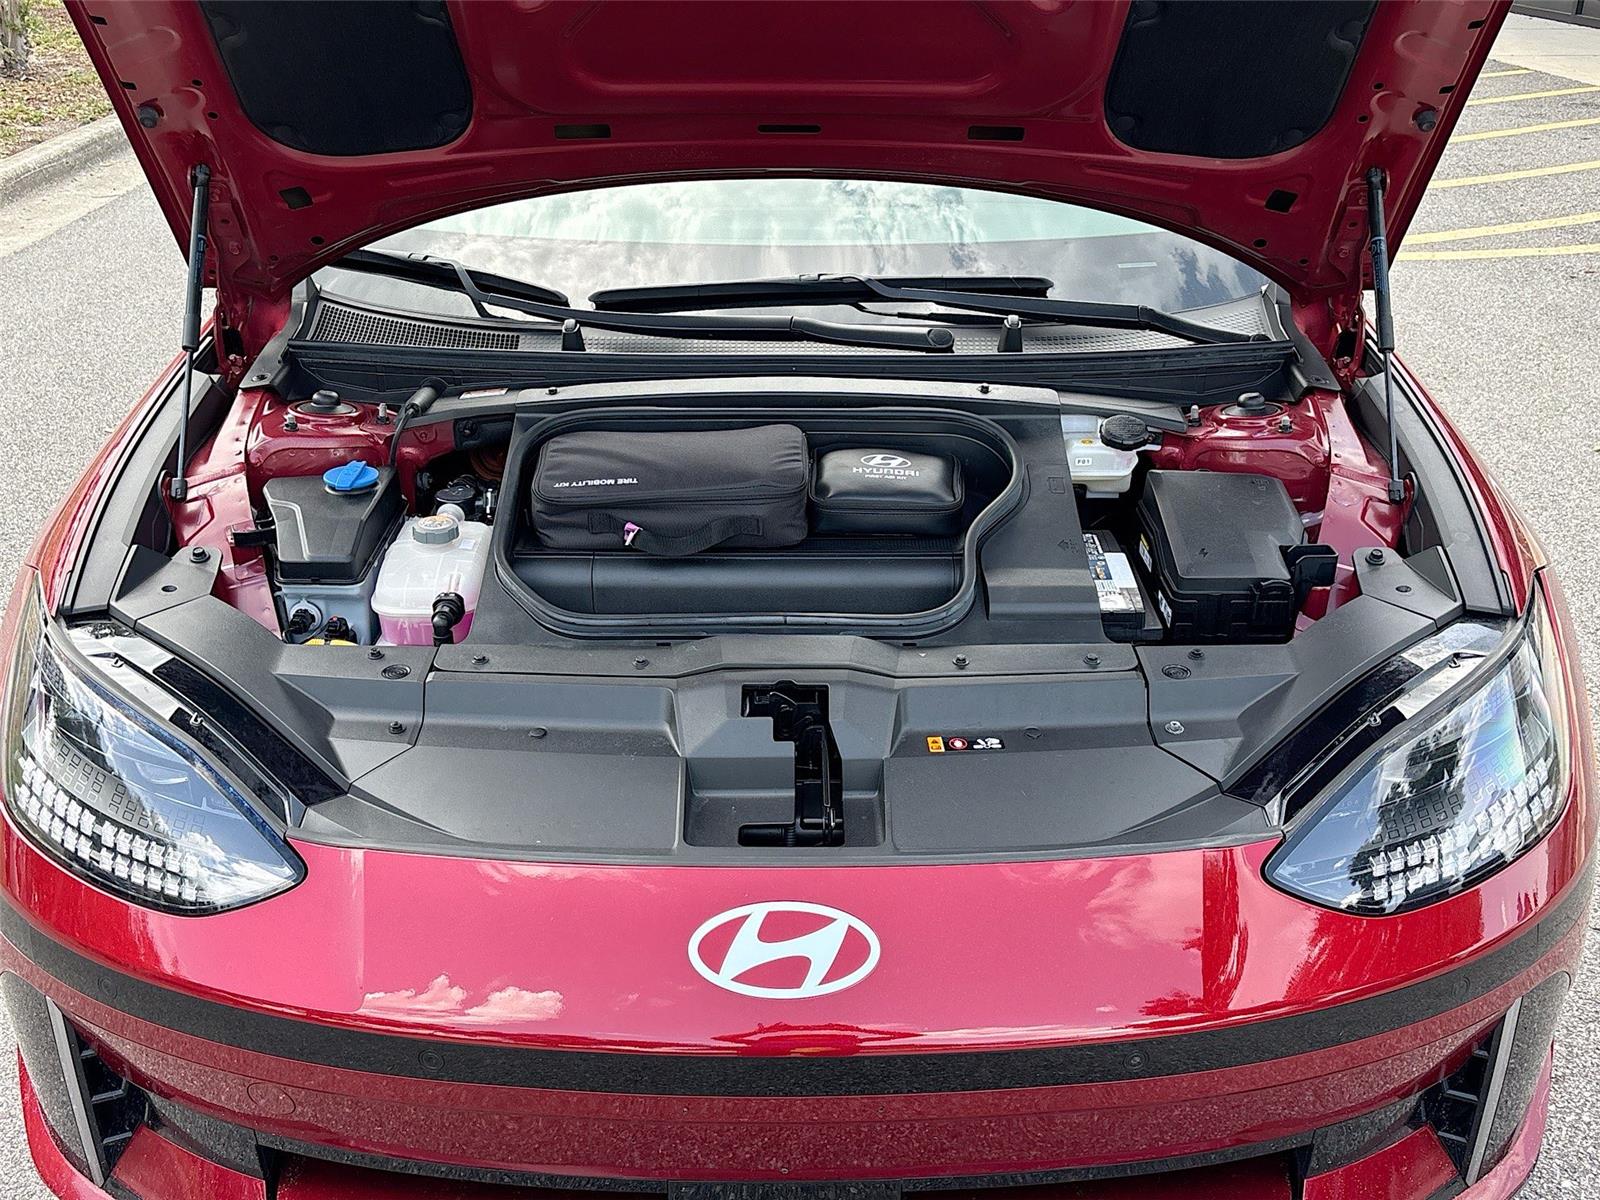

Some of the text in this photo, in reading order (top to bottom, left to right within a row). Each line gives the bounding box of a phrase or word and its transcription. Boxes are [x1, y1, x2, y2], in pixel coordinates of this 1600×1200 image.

[852, 467, 920, 477] HYUNDAI
[570, 479, 616, 487] MOBILITY
[617, 477, 639, 485] TIRE
